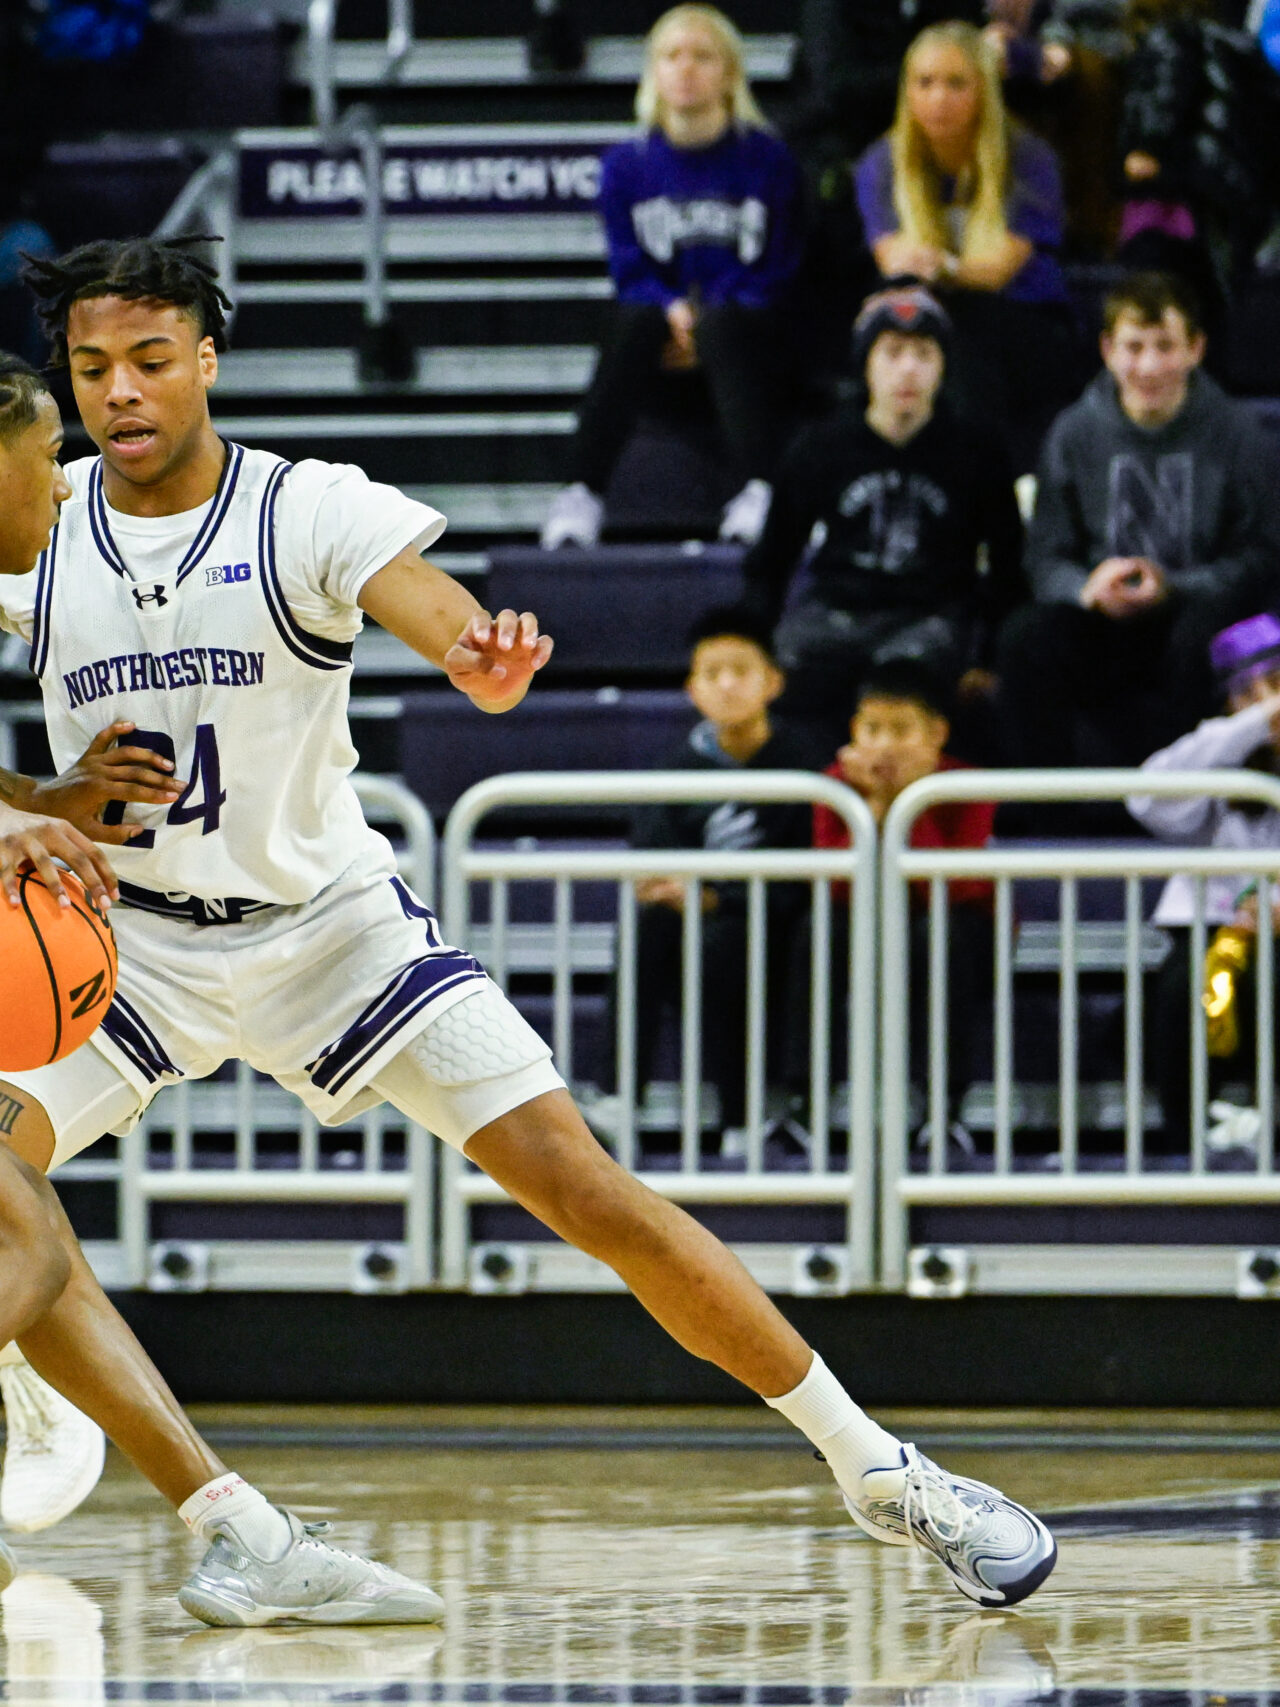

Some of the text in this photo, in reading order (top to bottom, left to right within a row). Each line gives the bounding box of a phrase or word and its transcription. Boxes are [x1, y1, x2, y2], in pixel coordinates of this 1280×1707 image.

[267, 158, 410, 202] PLEAE
[413, 157, 547, 200] WATCH
[63, 647, 265, 710] NORTHWESTERN
